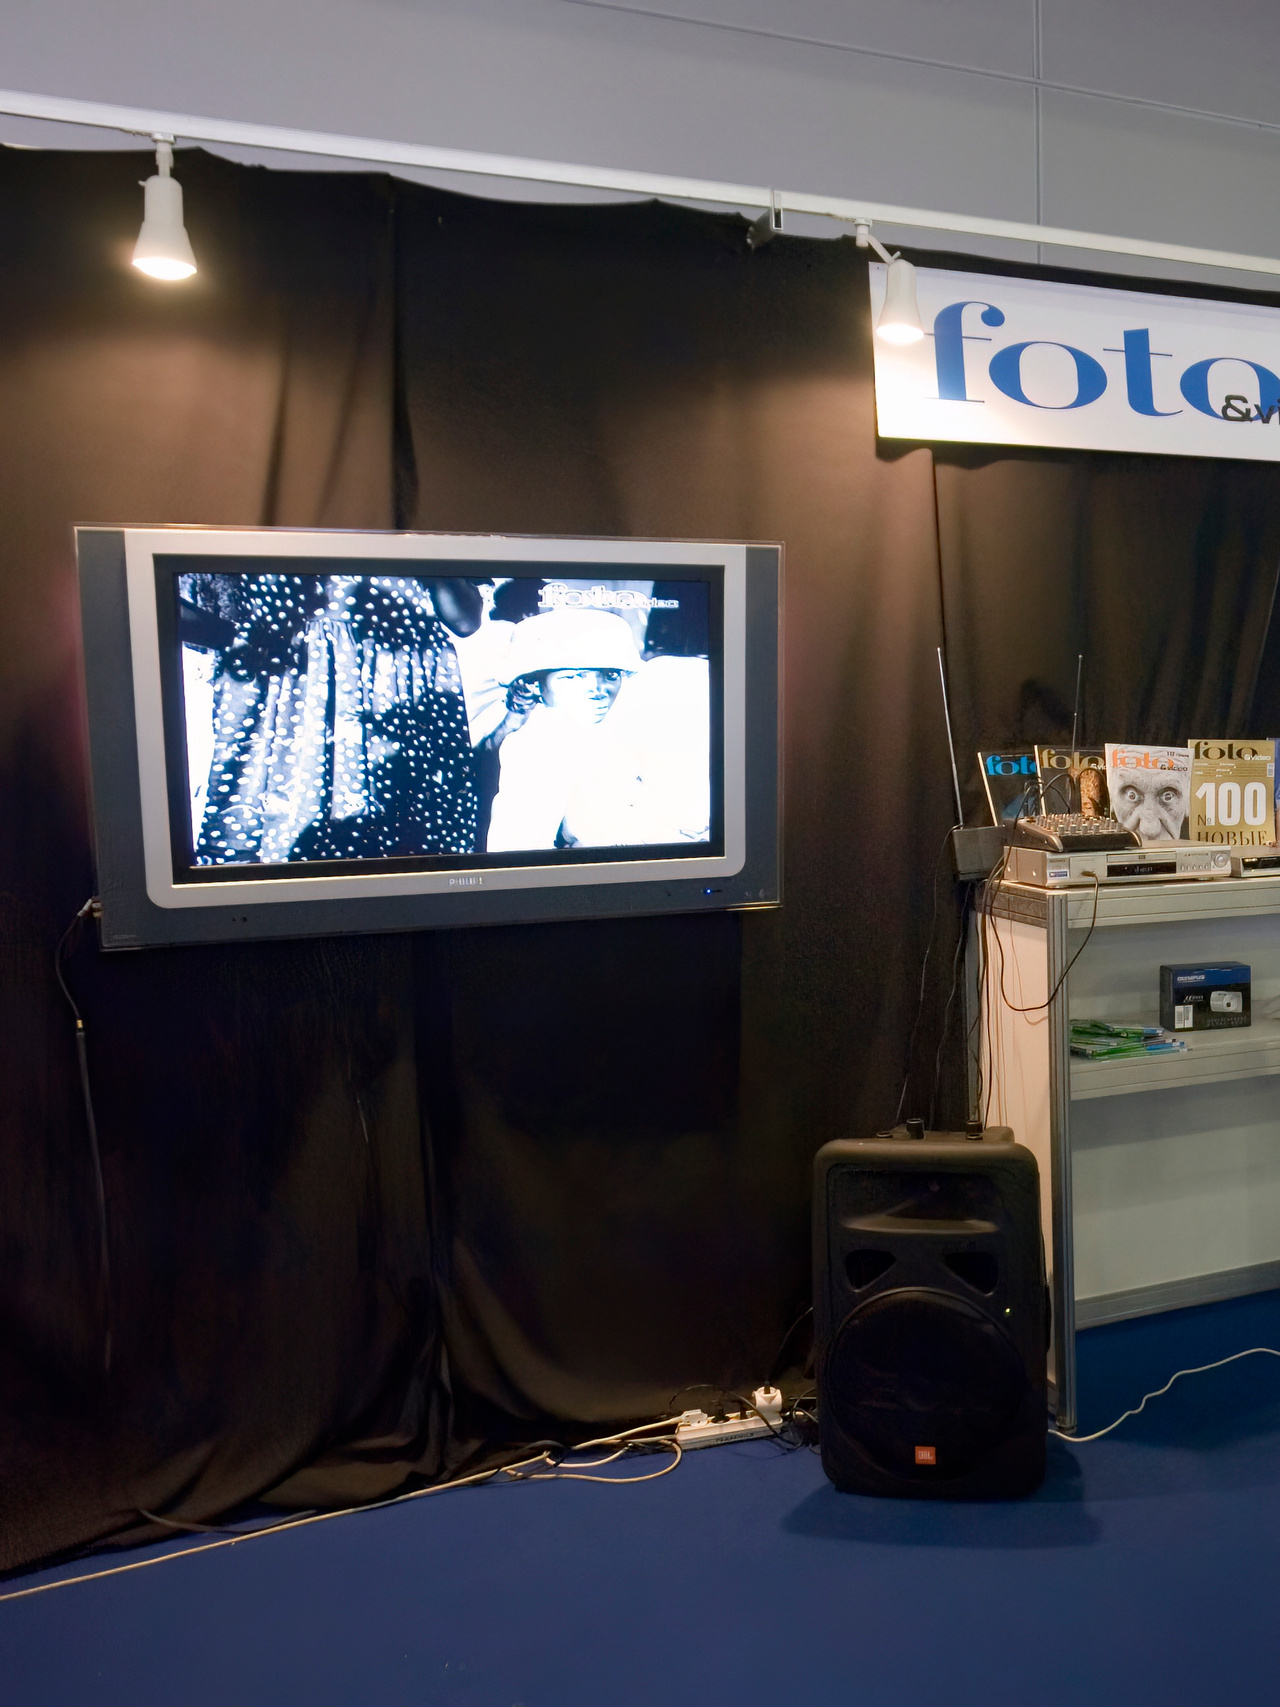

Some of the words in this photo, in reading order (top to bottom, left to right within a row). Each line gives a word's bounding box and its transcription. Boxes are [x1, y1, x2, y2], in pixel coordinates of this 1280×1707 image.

[1041, 748, 1105, 770] foto
[1194, 740, 1258, 760] foto
[1195, 782, 1267, 826] 100
